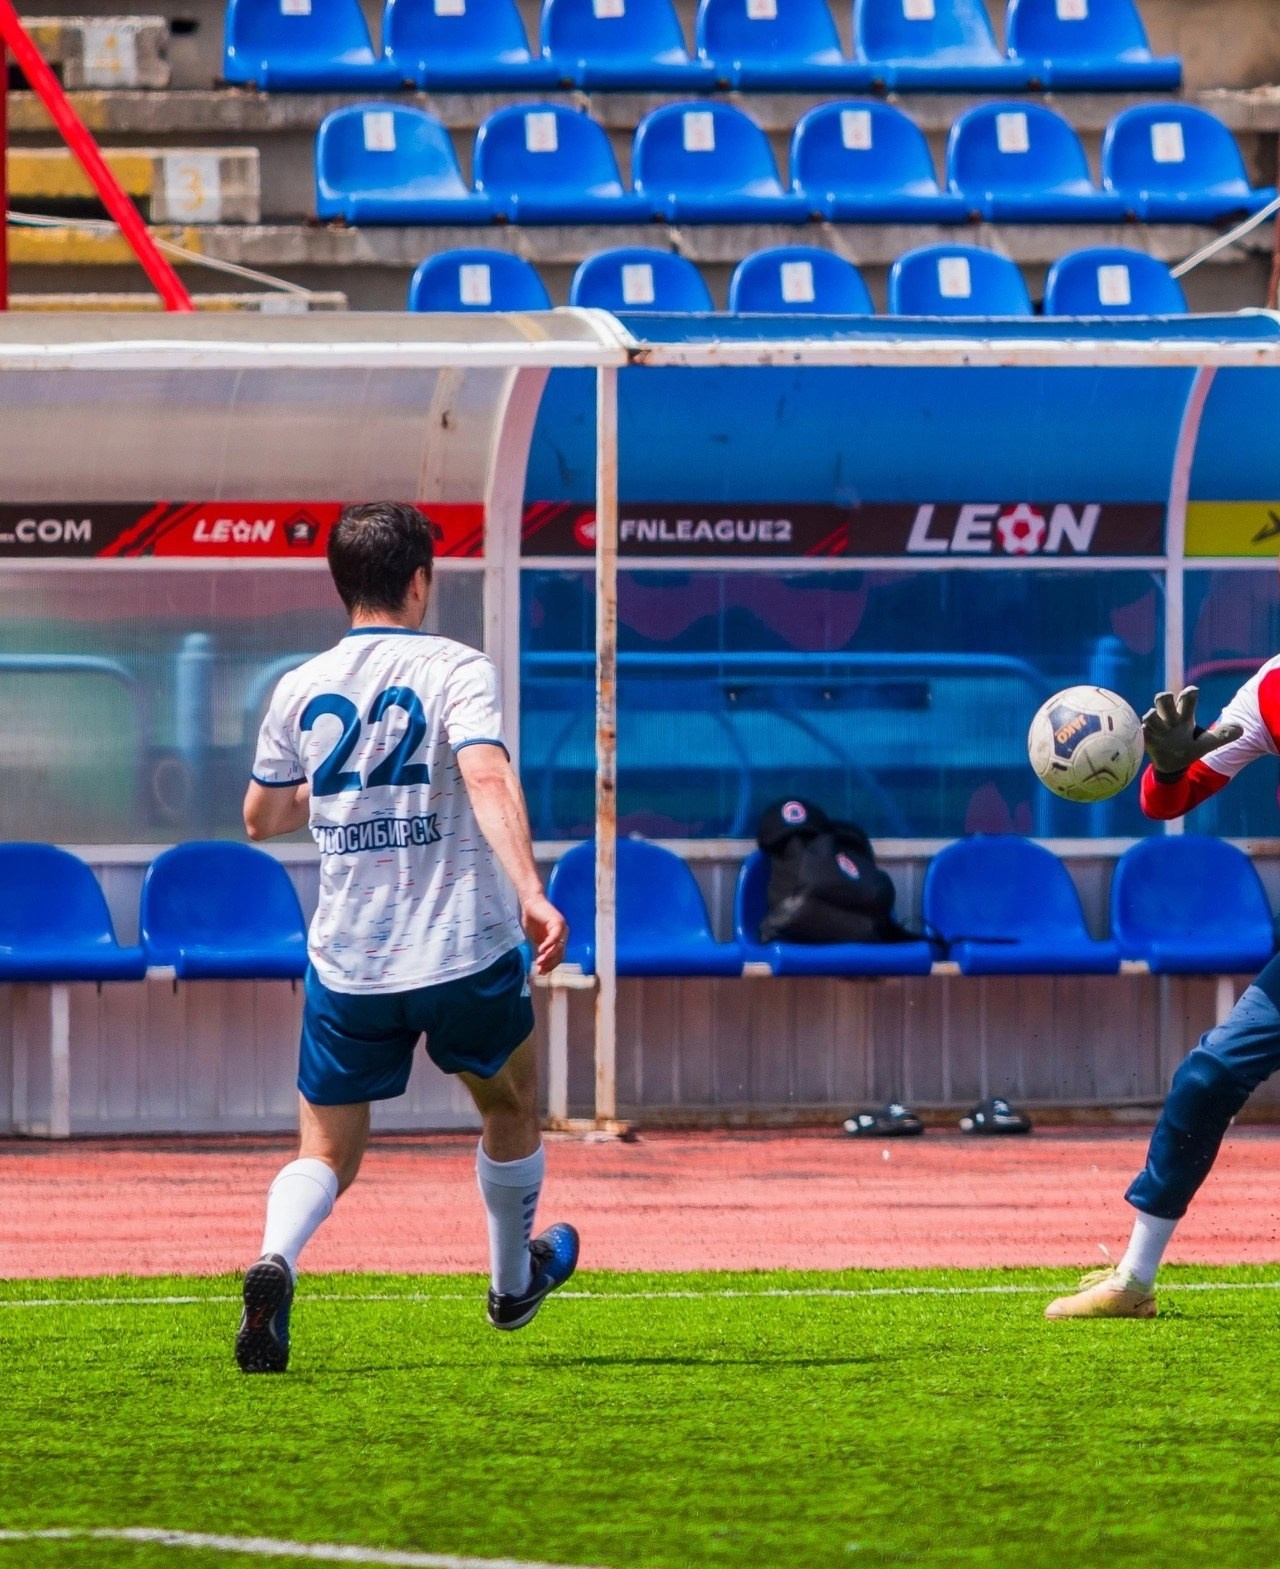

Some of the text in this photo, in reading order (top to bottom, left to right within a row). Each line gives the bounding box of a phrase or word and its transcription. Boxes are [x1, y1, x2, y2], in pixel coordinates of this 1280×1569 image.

[178, 164, 205, 212] 3
[619, 519, 793, 543] FNLEAGUE2
[299, 685, 431, 797] 22
[1055, 713, 1087, 745] JAKO
